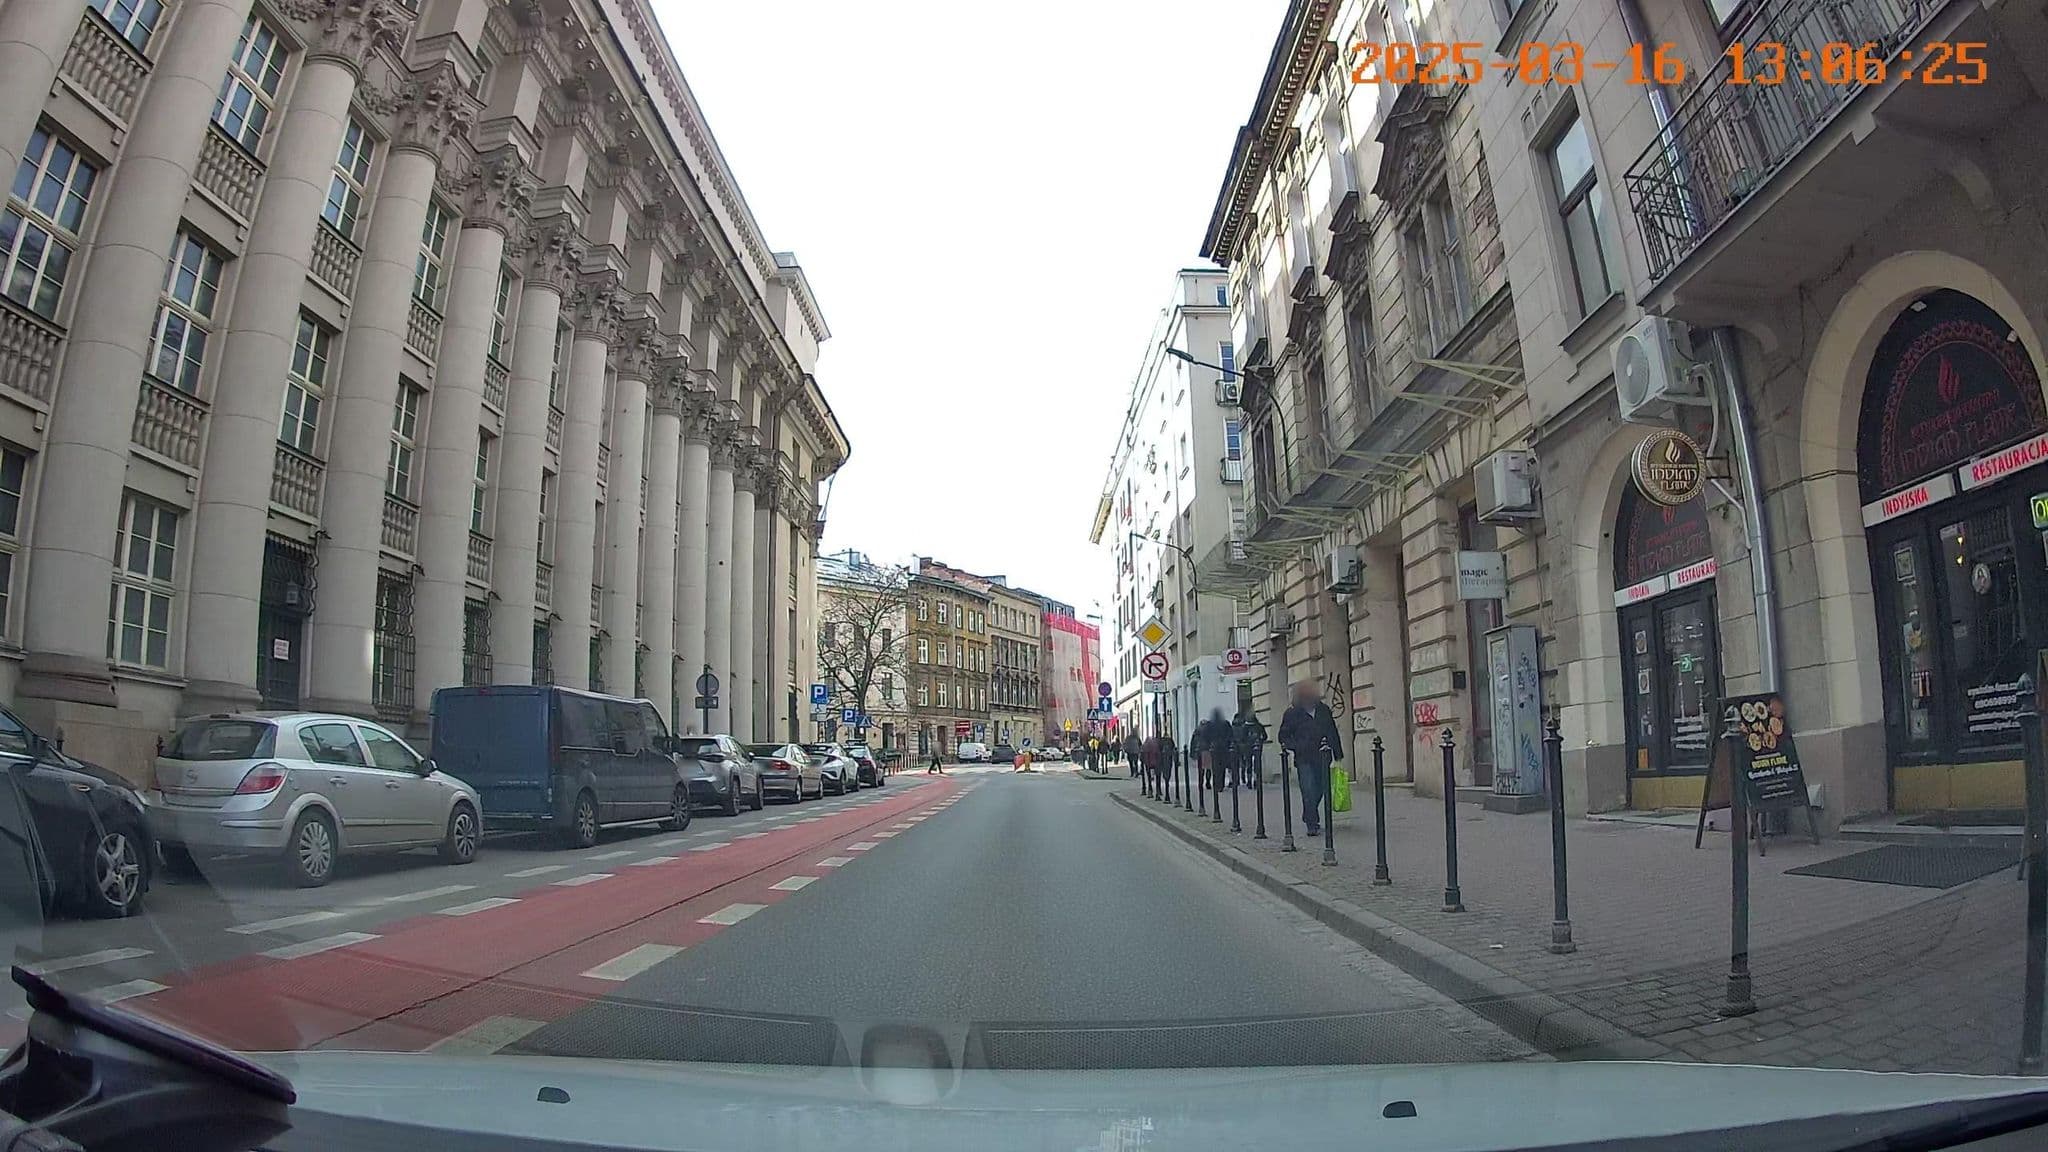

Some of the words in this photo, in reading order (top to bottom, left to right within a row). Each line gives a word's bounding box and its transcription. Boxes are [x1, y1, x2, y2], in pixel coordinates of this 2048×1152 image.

[1971, 438, 2048, 483] RESTAURACJA
[1881, 486, 1929, 518] INDYJSKA
[2035, 500, 2048, 520] O
[1461, 568, 1488, 578] magic
[1677, 561, 1718, 585] RESTAURAN
[814, 686, 824, 698] P
[844, 710, 853, 721] P
